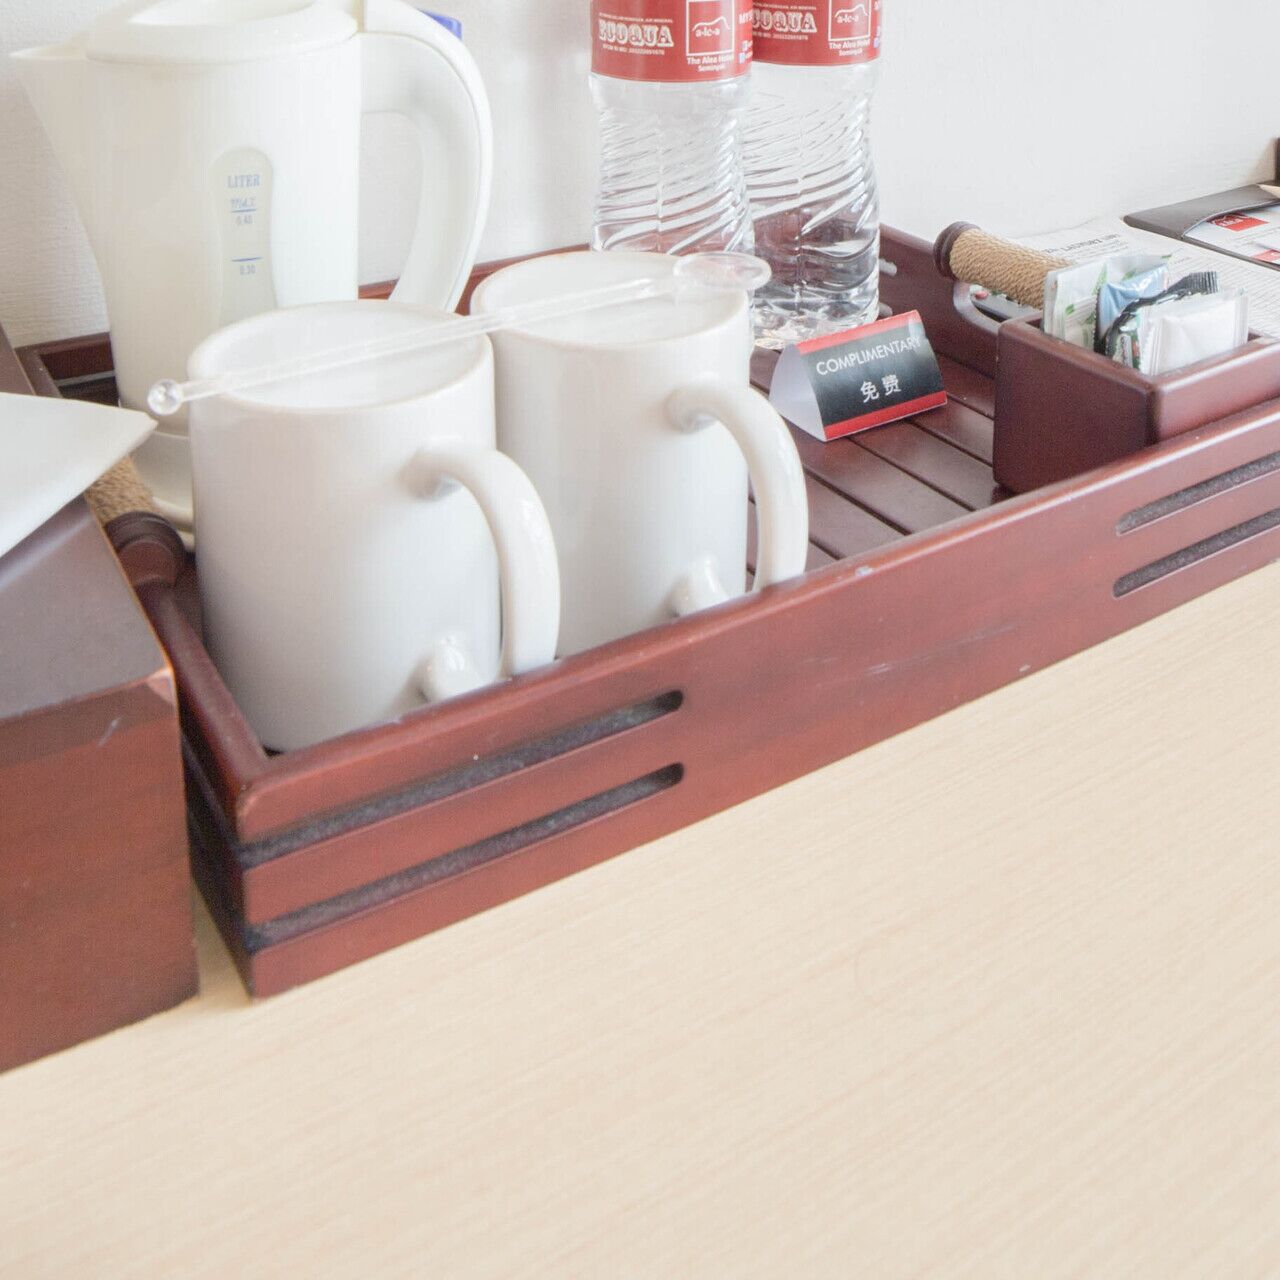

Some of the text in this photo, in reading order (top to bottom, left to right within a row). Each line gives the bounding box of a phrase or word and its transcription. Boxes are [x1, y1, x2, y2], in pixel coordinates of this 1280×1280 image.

[227, 174, 261, 188] LITER
[816, 336, 921, 376] COMPLIMENTARY
[860, 373, 902, 403] 免费
